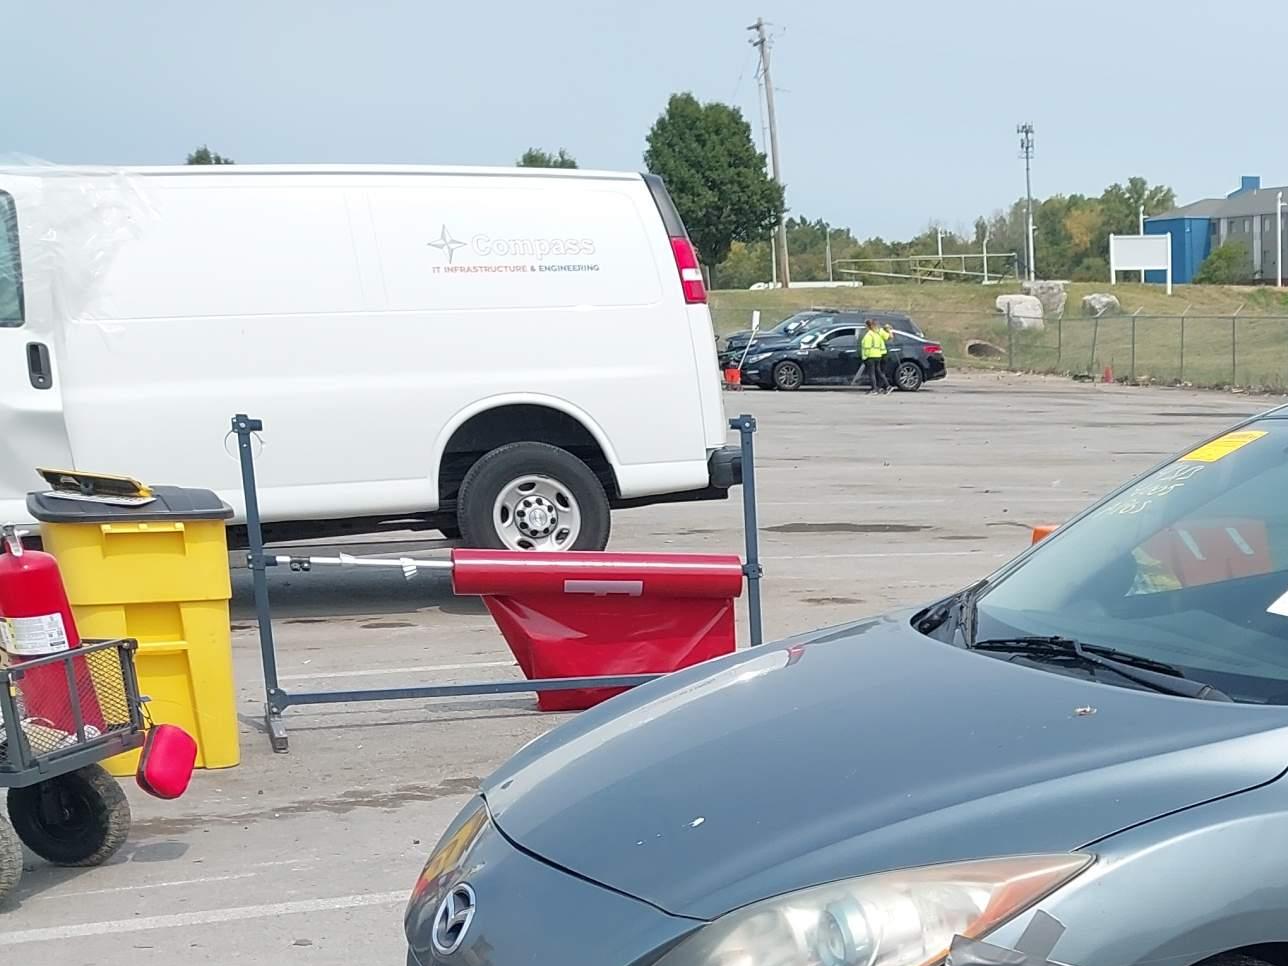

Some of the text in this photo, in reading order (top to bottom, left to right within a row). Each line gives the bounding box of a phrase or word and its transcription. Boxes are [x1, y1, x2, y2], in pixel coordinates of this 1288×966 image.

[472, 234, 596, 260] Compass
[432, 264, 601, 274] IT INFRASTRUCTURE & ENGINEERING
